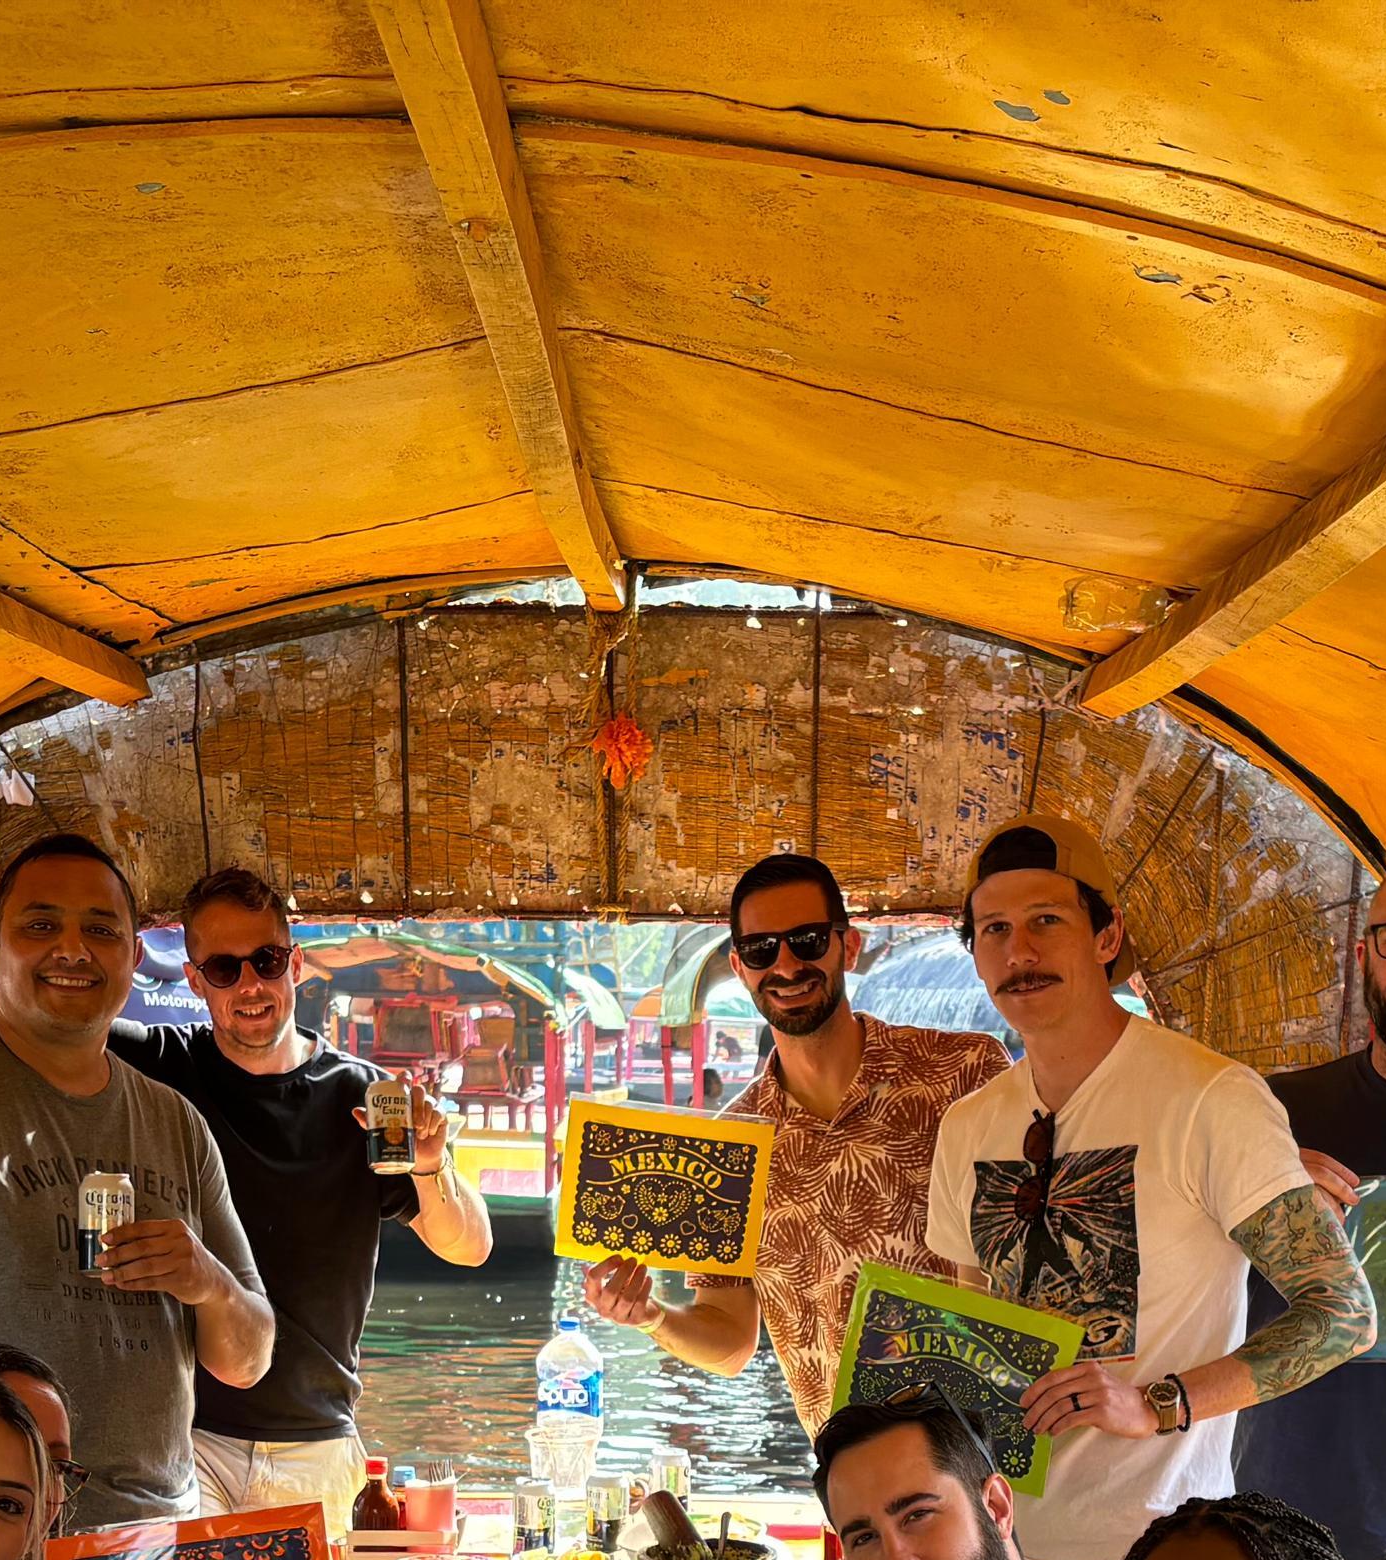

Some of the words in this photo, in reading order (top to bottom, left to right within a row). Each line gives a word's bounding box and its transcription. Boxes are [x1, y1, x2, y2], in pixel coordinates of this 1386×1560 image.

[12, 1157, 69, 1197] JACK
[609, 1150, 723, 1189] MEXICO
[893, 1331, 1011, 1388] MEXICO
